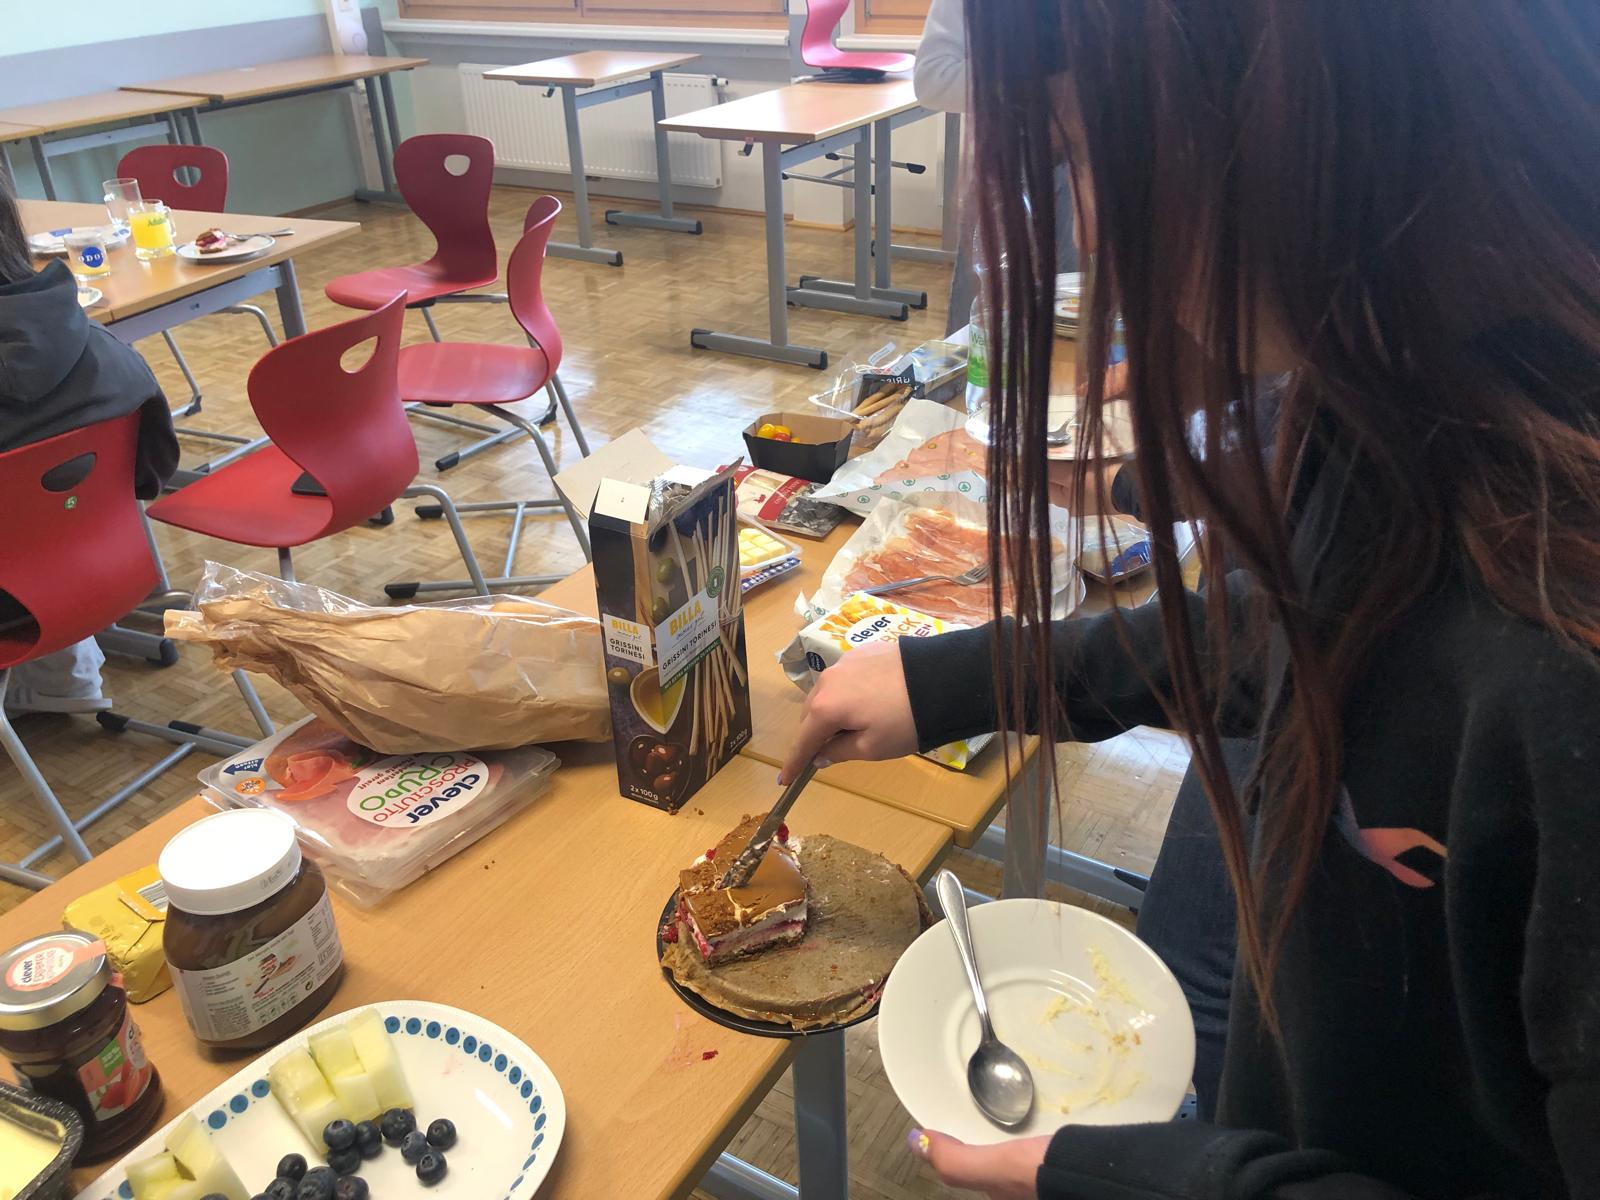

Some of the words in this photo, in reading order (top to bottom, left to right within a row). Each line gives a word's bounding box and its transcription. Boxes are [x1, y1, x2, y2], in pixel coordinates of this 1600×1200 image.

[611, 618, 639, 635] BILLA
[669, 600, 702, 636] BILLA
[850, 616, 891, 643] clever
[879, 617, 922, 643] BÄCK
[609, 638, 643, 652] GRISSINI
[609, 645, 645, 660] TORINESI
[662, 644, 689, 671] GRISSINI
[689, 621, 717, 647] TORINESI
[358, 754, 456, 812] CRUDO
[372, 759, 479, 823] PROSCIUTTO
[405, 773, 481, 825] clever
[21, 959, 33, 983] clever
